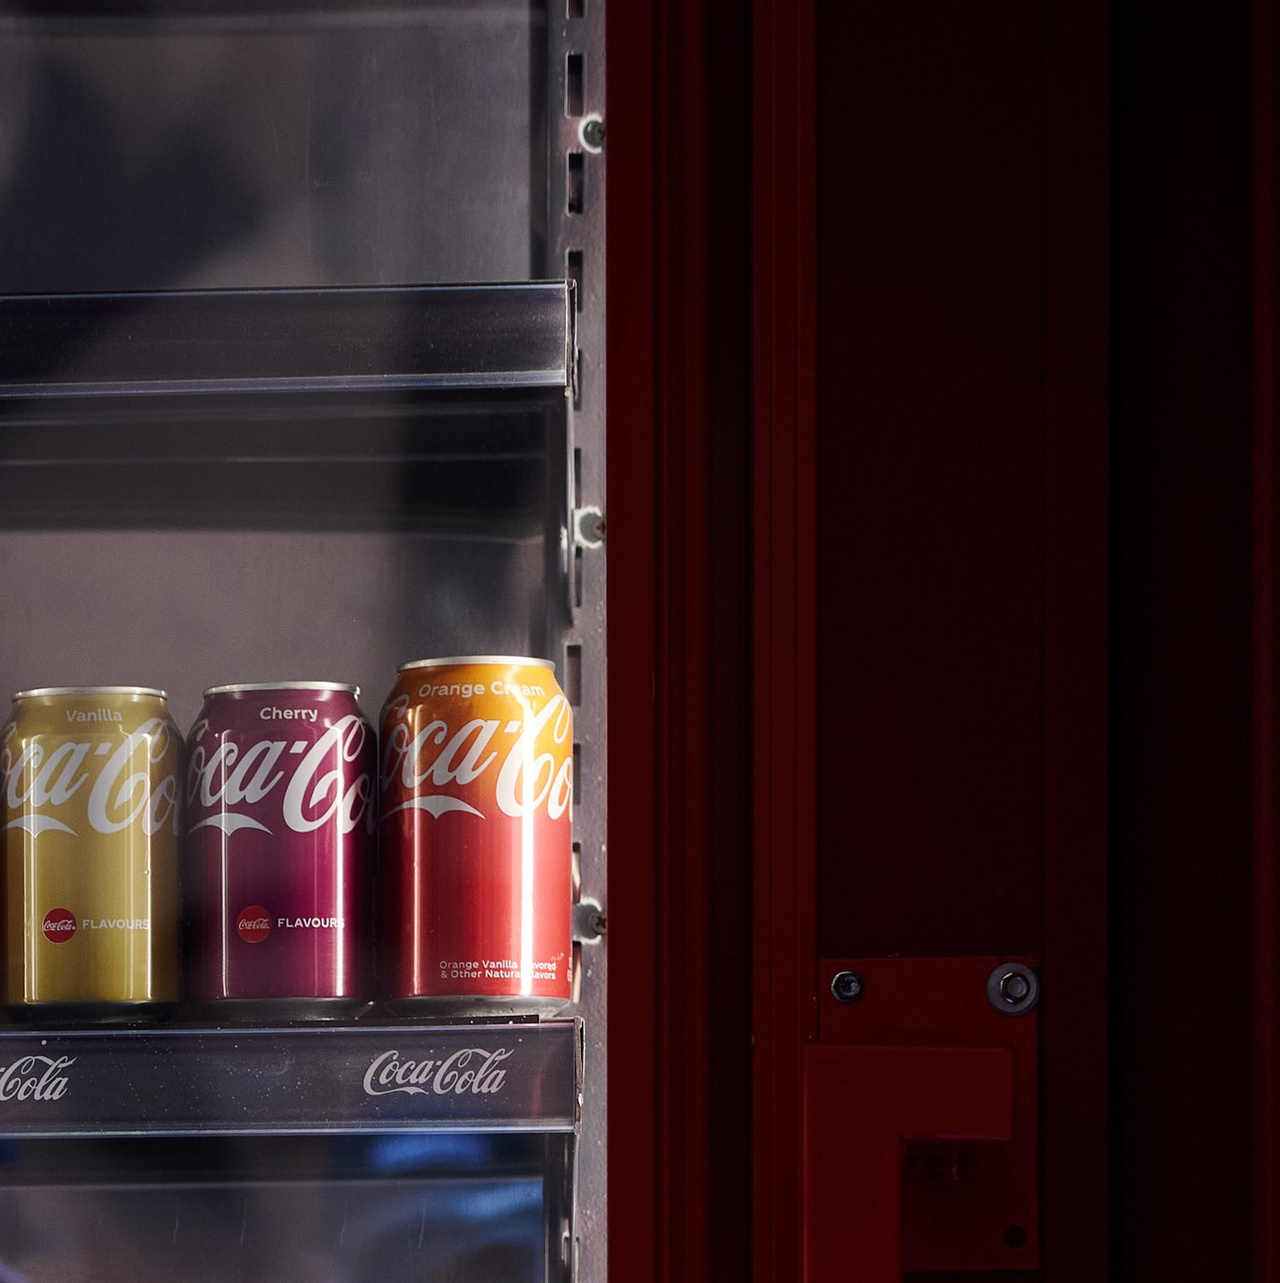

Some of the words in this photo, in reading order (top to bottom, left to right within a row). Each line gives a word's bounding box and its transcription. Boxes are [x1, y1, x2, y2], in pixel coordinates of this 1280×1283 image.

[66, 709, 124, 722] Vanilla
[260, 707, 318, 722] Cherry
[82, 919, 150, 930] FLAVOURS
[363, 1048, 514, 1095] Coca-Cola
